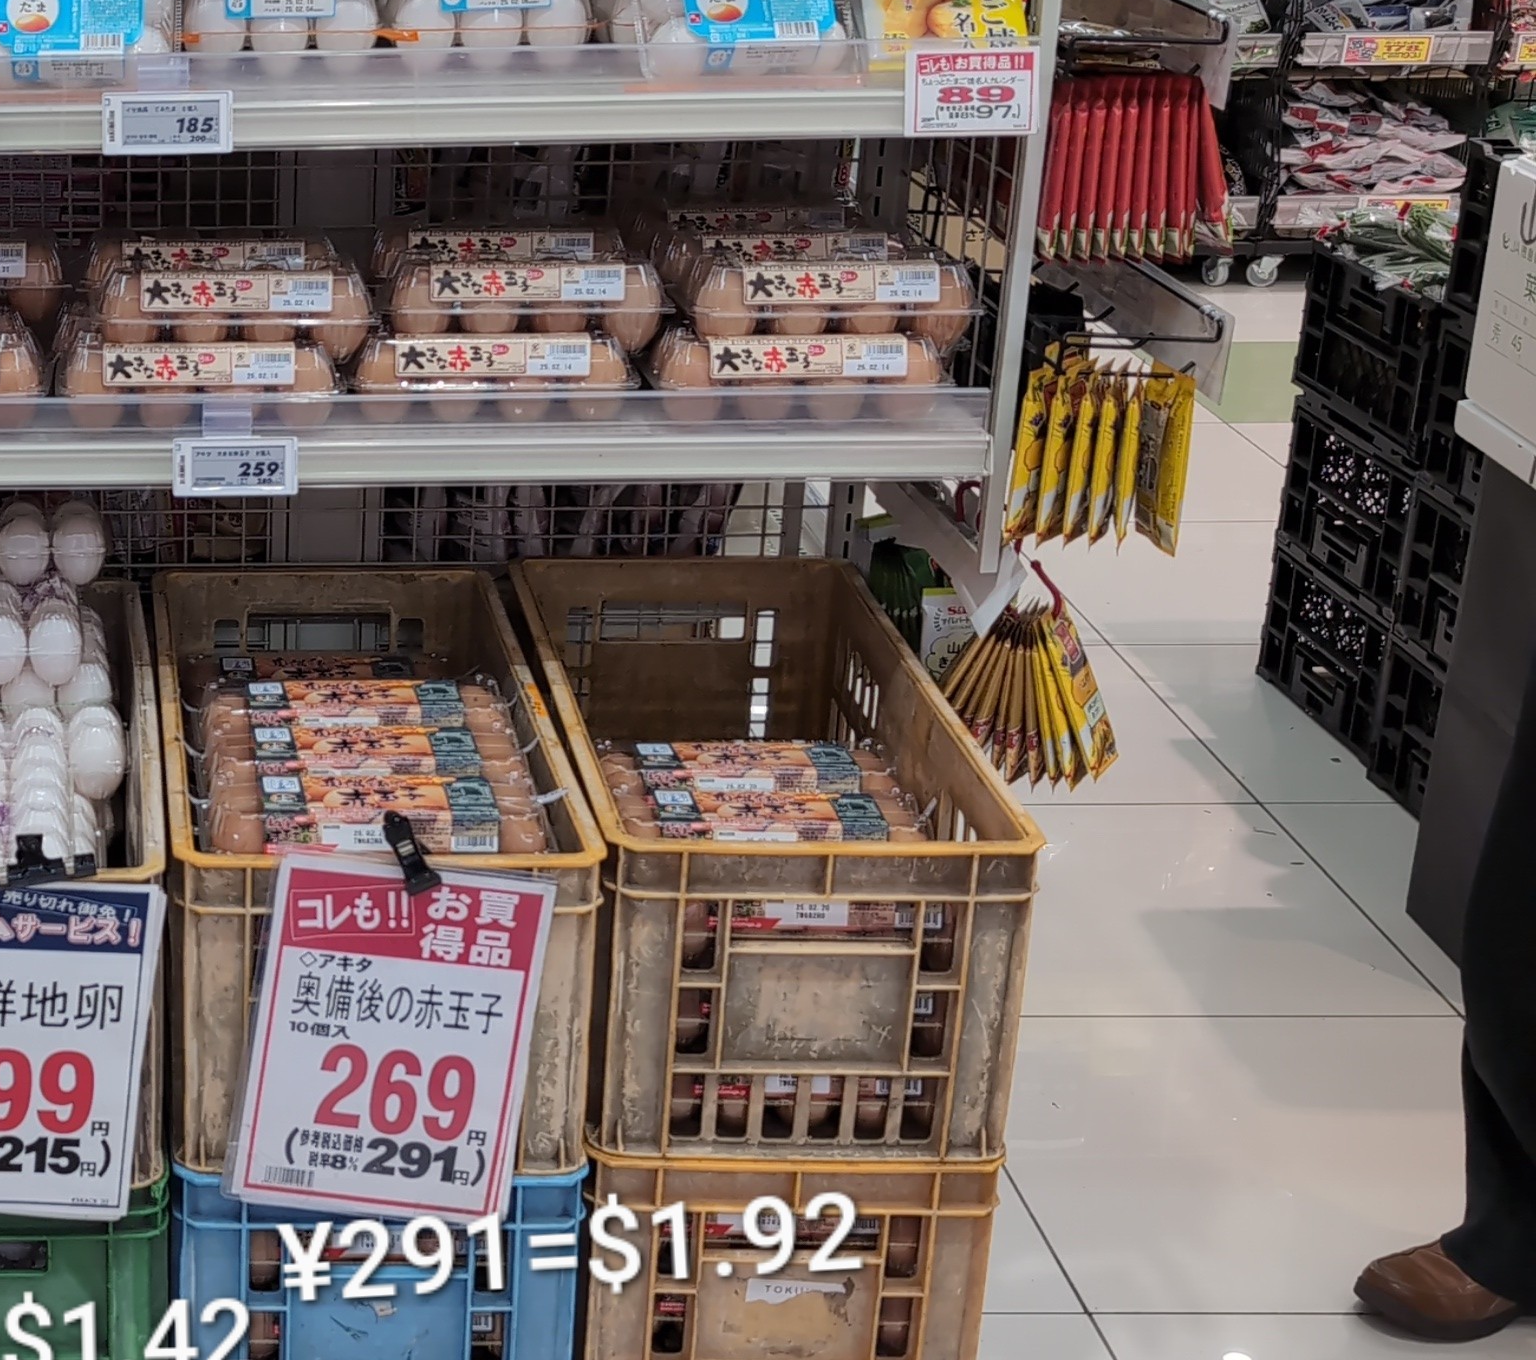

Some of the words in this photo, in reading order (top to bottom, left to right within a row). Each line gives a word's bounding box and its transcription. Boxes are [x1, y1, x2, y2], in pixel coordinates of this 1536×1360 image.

[920, 57, 950, 73] コレも
[936, 85, 1016, 104] 89
[176, 117, 214, 134] 185
[144, 279, 239, 307] 大きな赤玉子
[433, 269, 529, 297] 大きな赤玉子
[747, 270, 845, 300] 大きな赤玉子
[108, 354, 201, 382] 大きな赤玉子
[399, 344, 495, 372] 大きな赤玉子
[713, 345, 810, 373] 大きな赤玉子
[237, 461, 280, 478] 259
[290, 971, 504, 1036] 奥備後の赤玉子
[289, 1020, 351, 1040] 10個入
